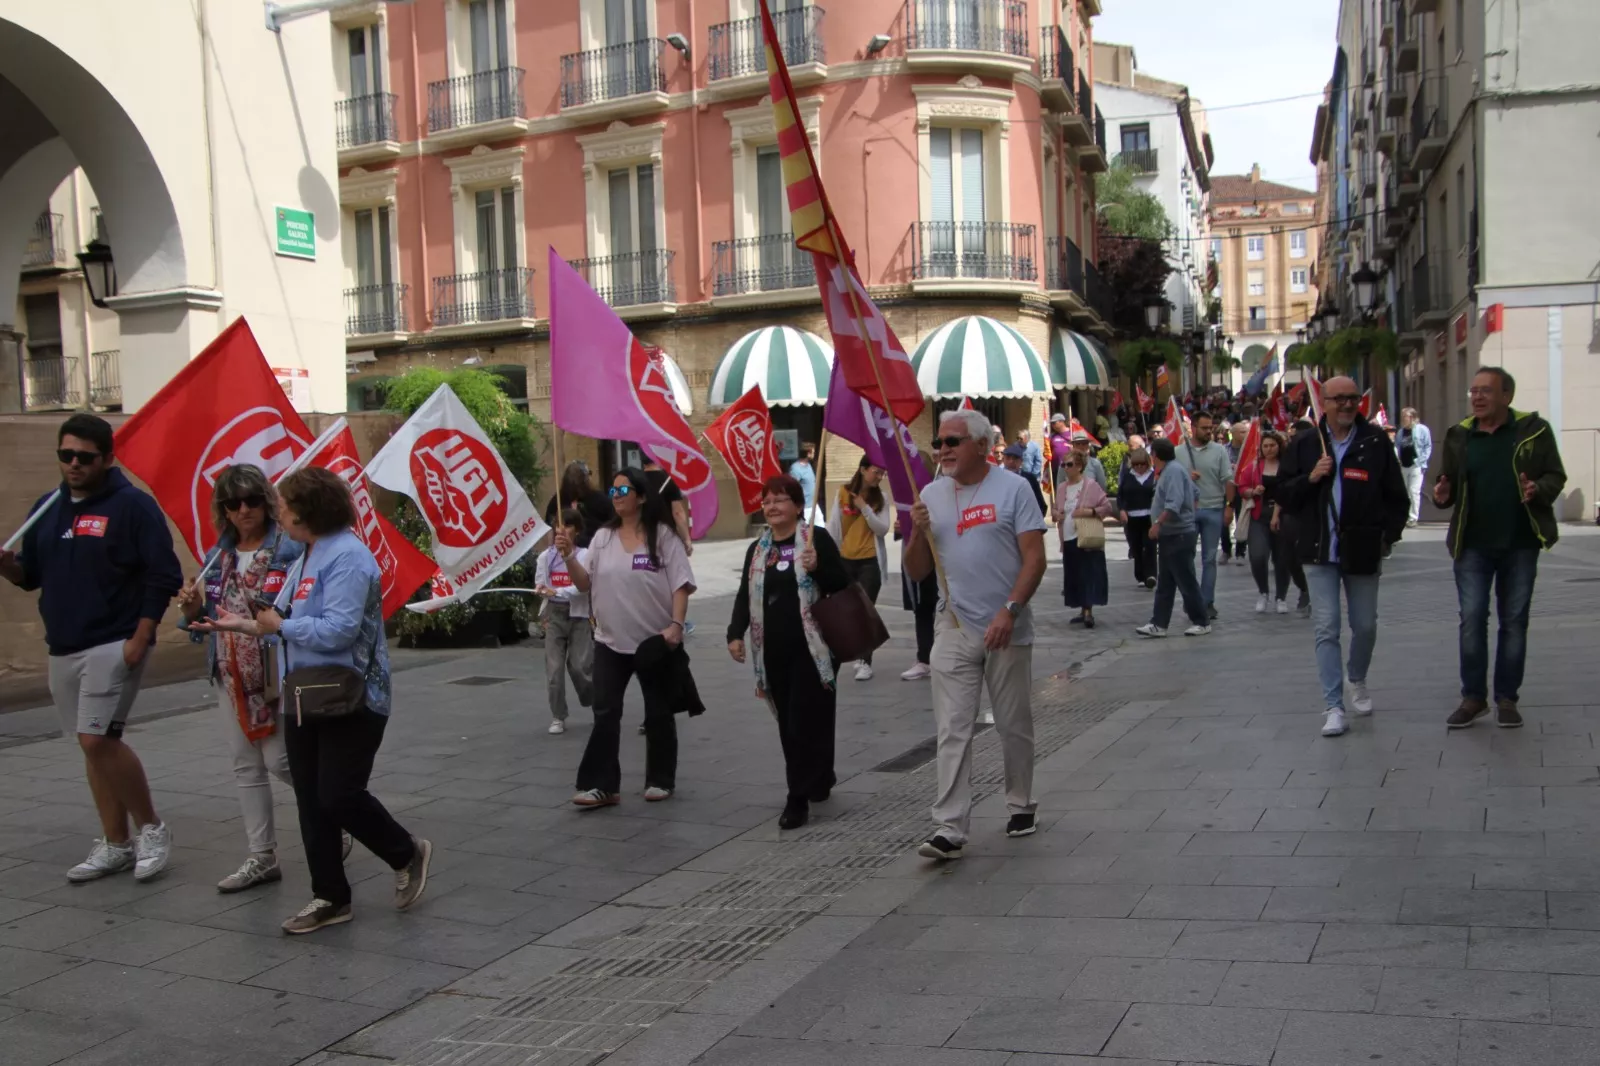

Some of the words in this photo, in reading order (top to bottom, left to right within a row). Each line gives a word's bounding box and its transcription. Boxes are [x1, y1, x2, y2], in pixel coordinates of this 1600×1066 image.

[433, 434, 504, 518] UGT
[965, 510, 981, 521] UGT
[454, 516, 537, 588] www.UGT.es
[633, 557, 649, 565] UGT
